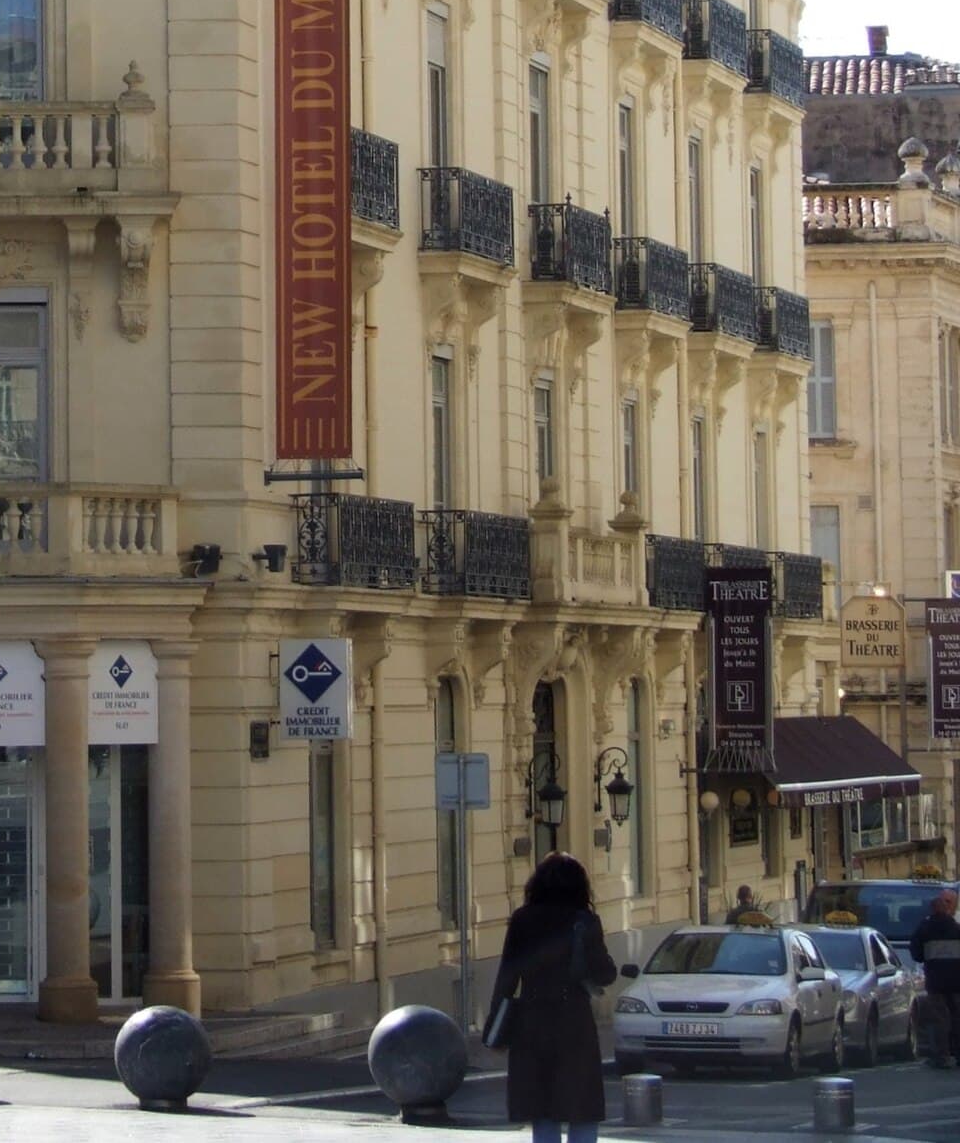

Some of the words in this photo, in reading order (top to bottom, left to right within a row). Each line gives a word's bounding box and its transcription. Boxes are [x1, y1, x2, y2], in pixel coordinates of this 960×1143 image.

[292, 50, 336, 112] DU
[292, 126, 336, 282] HOTEL
[292, 300, 336, 404] NEW
[709, 580, 768, 600] THEATRE
[724, 615, 754, 623] OUVERT
[730, 626, 750, 634] TOUS
[846, 620, 900, 632] BRASSERIE
[735, 638, 759, 646] JOURS
[866, 633, 879, 642] DU
[846, 640, 900, 658] THEATRE
[286, 717, 340, 726] IMMOBILIER
[288, 727, 301, 736] DE
[304, 727, 339, 736] FRANCE
